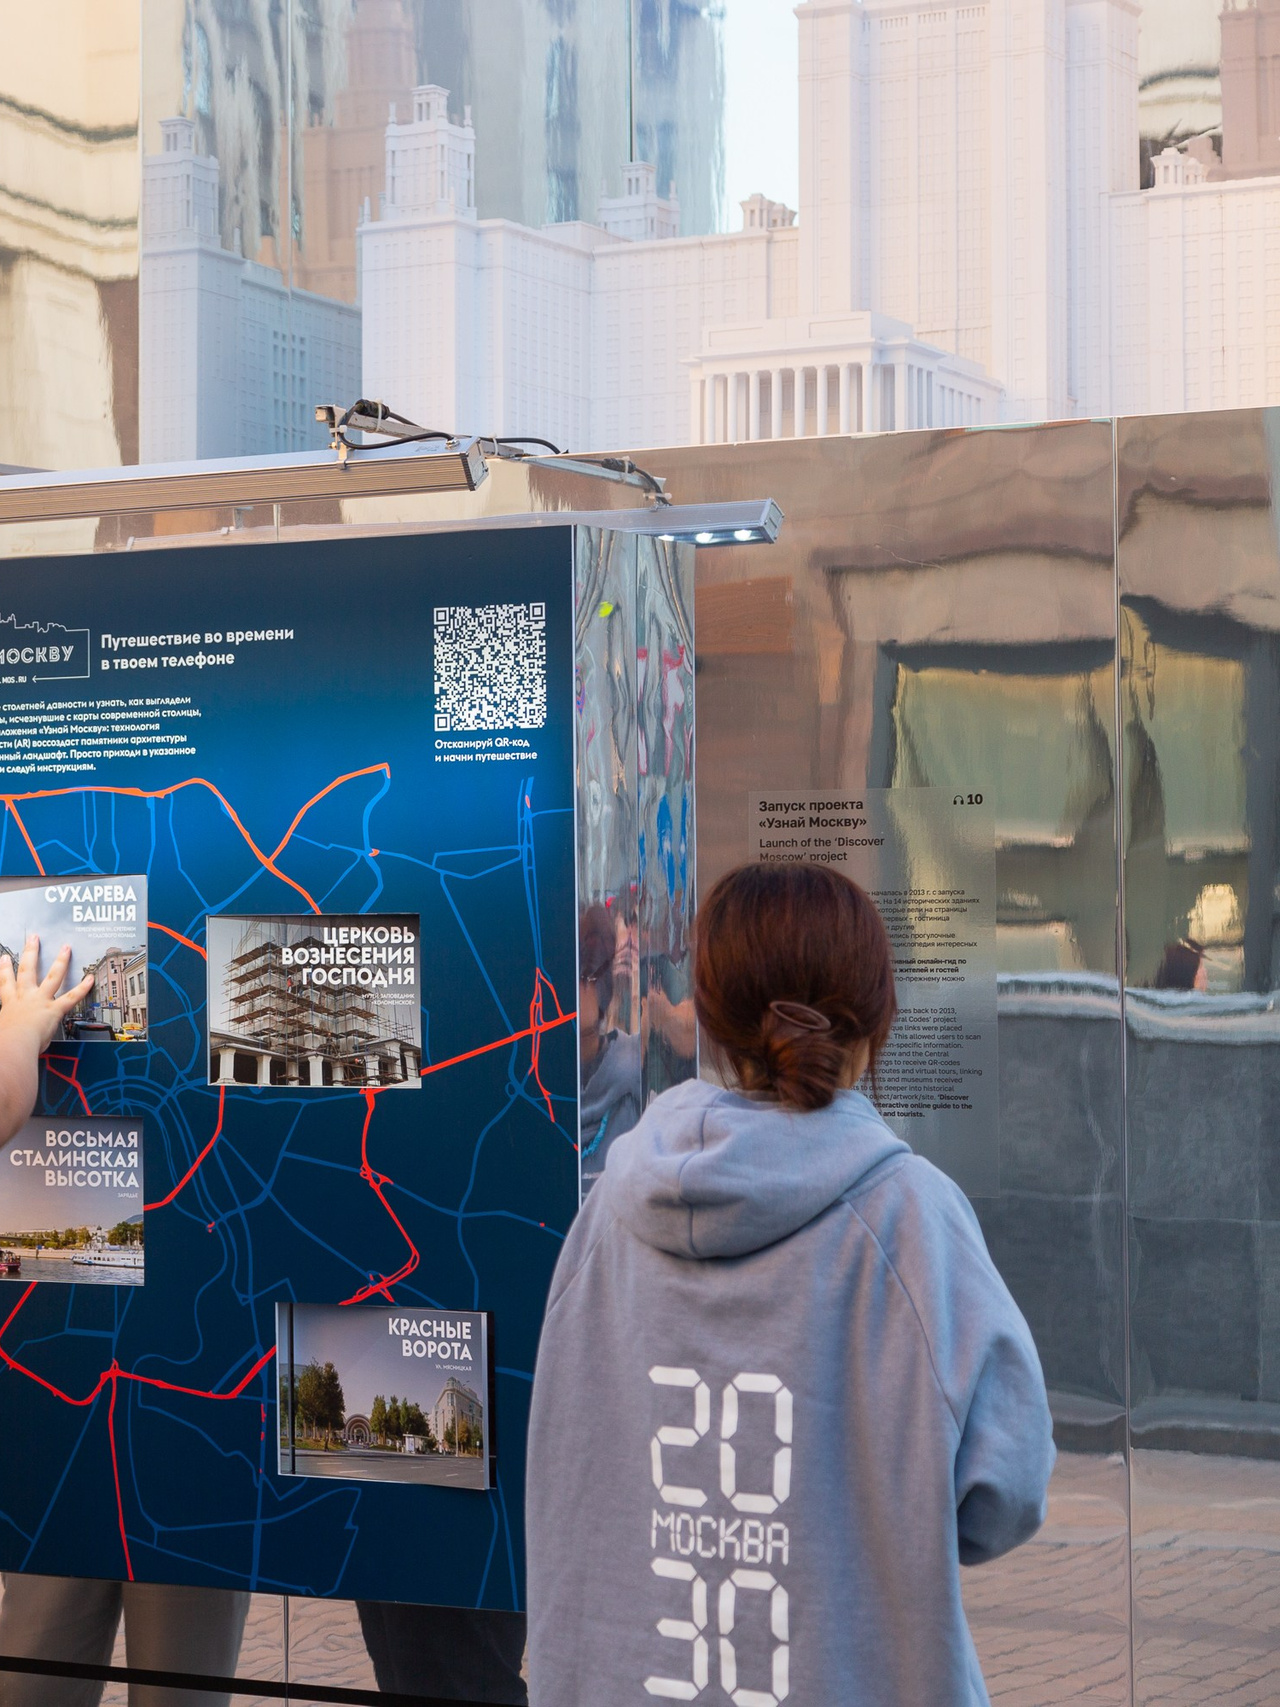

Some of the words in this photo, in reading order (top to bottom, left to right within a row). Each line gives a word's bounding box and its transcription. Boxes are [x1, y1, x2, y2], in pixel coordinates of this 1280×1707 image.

[101, 633, 200, 651] Путешествие
[204, 632, 222, 644] во
[226, 628, 294, 645] времени
[101, 659, 110, 670] в
[113, 657, 157, 669] твоем
[161, 651, 235, 669] телефоне
[3, 701, 45, 711] столетней
[47, 701, 87, 710] давности
[96, 699, 127, 709] узнать,
[129, 698, 144, 706] как
[146, 696, 191, 706] выглядели
[9, 713, 65, 724] исчезнувшие
[73, 713, 99, 722] карты
[101, 709, 160, 721] современной
[162, 708, 201, 718] столицы,
[39, 724, 68, 735] «Узнай
[70, 725, 109, 734] Москву»:
[111, 723, 159, 732] технология
[14, 739, 31, 749] (AR)
[32, 738, 79, 748] воссоздаст
[81, 737, 128, 746] памятники
[130, 734, 187, 745] архитектуры
[435, 738, 493, 749] Отсканируй
[495, 737, 530, 747] QR-код
[22, 749, 68, 762] ландшафт.
[70, 749, 102, 759] Просто
[103, 748, 140, 758] приходи
[149, 747, 196, 757] указанное
[443, 754, 473, 762] начни
[476, 752, 537, 762] путешествие
[6, 764, 35, 774] следуй
[37, 762, 96, 773] инструкциям.
[967, 794, 983, 804] 10
[759, 801, 805, 814] Запуск
[810, 801, 863, 813] проекта
[759, 817, 805, 828] «Узнай
[809, 817, 866, 829] Москву»
[760, 839, 797, 848] Launch
[801, 838, 811, 847] of
[814, 838, 831, 846] the
[810, 852, 847, 863] project
[45, 885, 137, 903] СУХАРЕВА
[73, 904, 136, 922] БАШНЯ
[324, 927, 415, 946] ЦЕРКОВЬ
[282, 947, 415, 965] ВОЗНЕСЕНИЯ
[302, 968, 415, 987] ГОСПОДНЯ
[933, 1016, 956, 1024] project
[960, 1068, 983, 1076] linking
[46, 1130, 138, 1147] ВОСЬМАЯ
[10, 1151, 138, 1167] СТАЛИНСКАЯ
[45, 1170, 139, 1187] ВЫСОТКА
[388, 1318, 472, 1340] КРАСНЫЕ
[402, 1340, 472, 1360] ВОРОТА
[648, 1365, 793, 1514] 20
[650, 1509, 789, 1566] МОСКВА
[643, 1557, 789, 1707] 30
